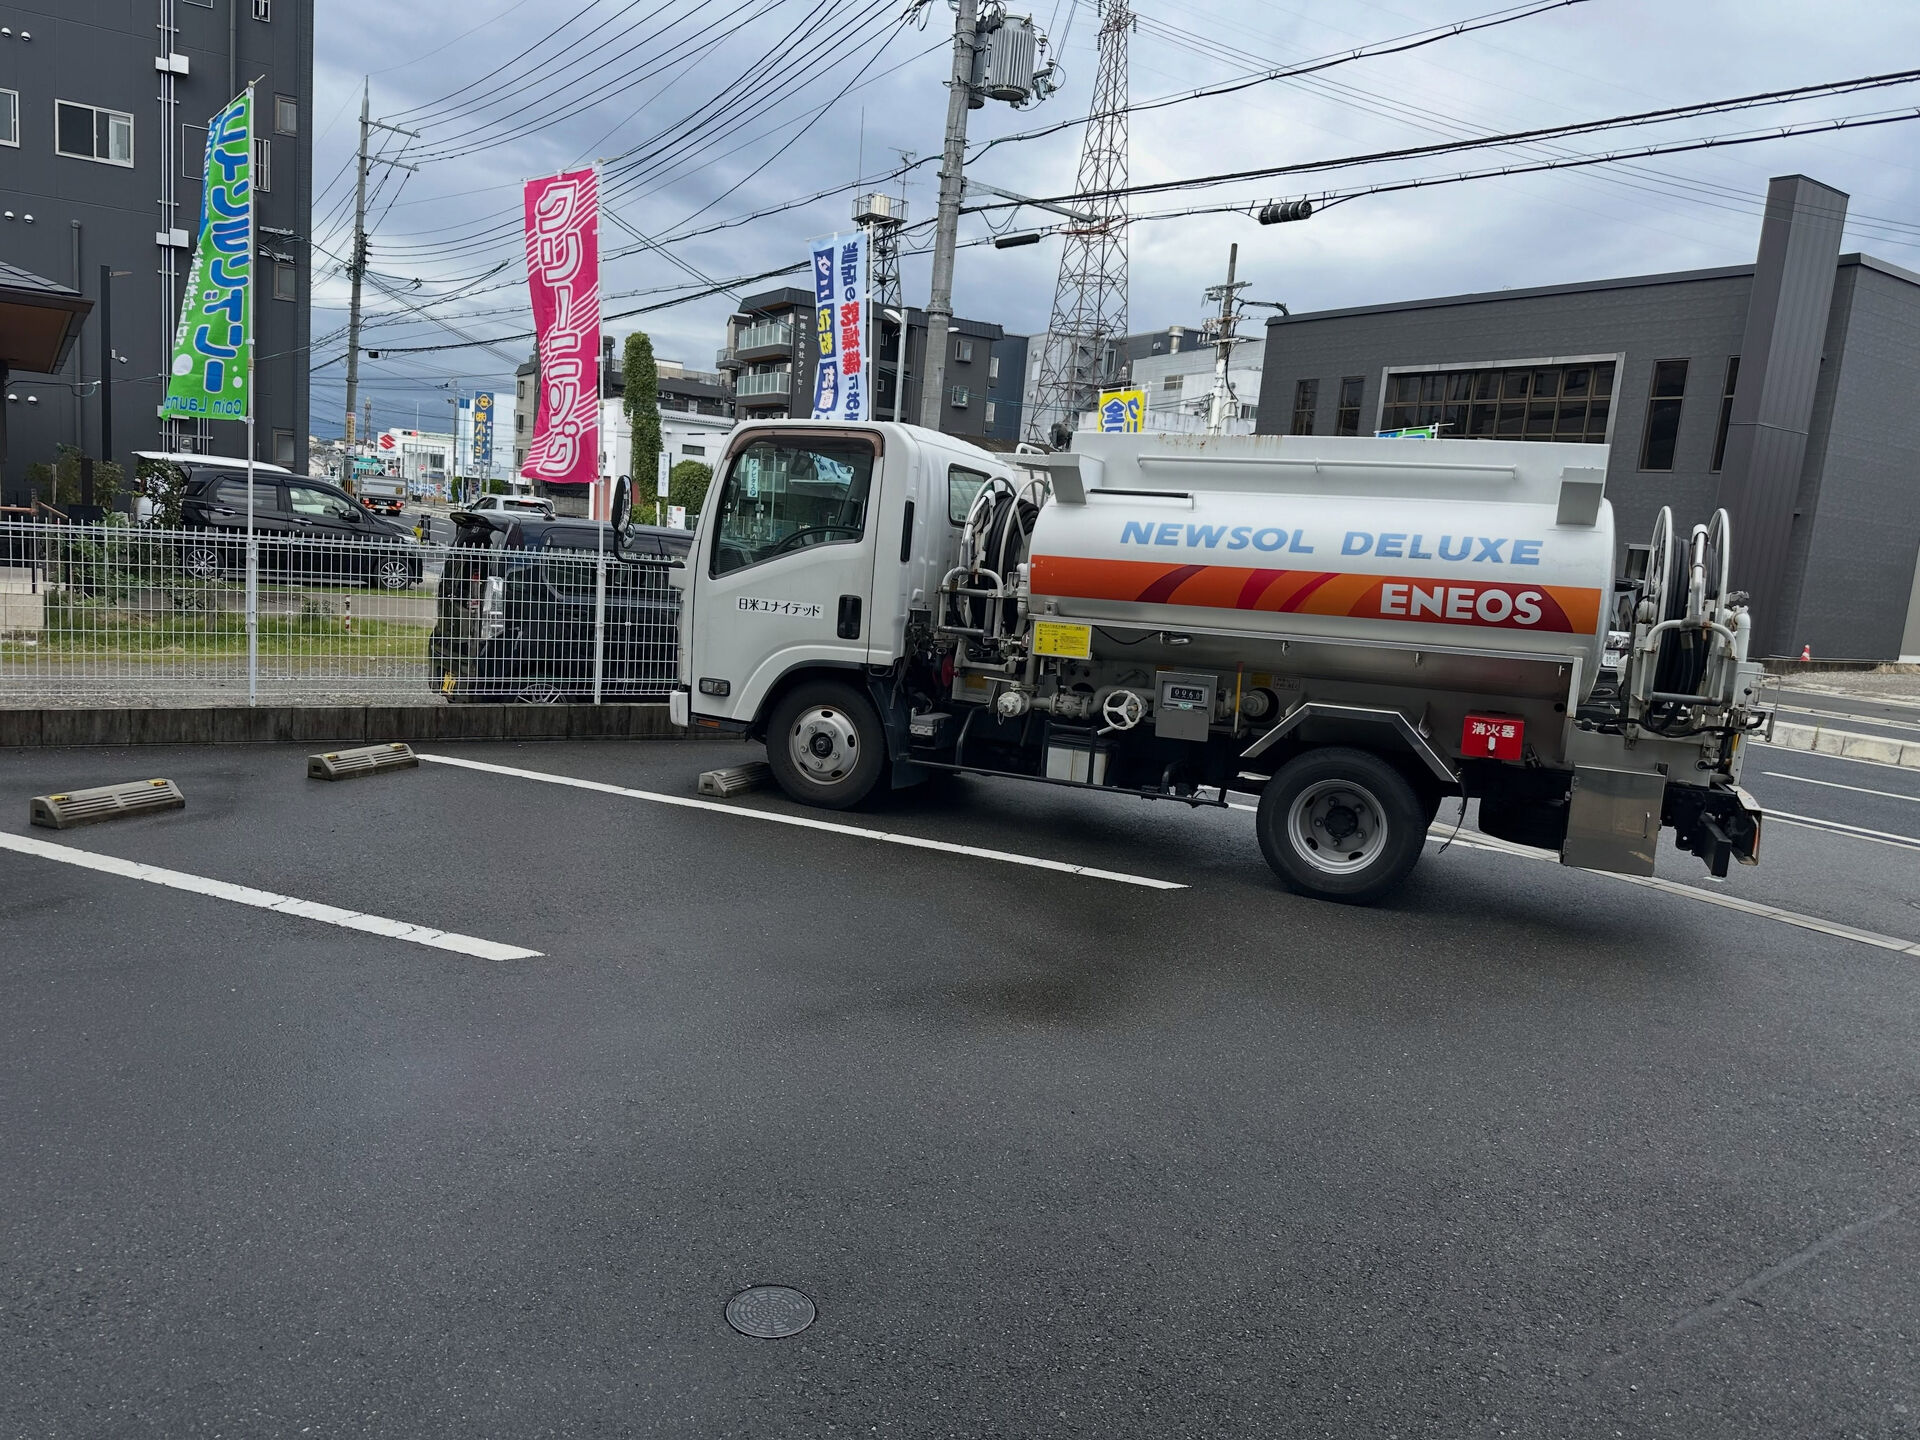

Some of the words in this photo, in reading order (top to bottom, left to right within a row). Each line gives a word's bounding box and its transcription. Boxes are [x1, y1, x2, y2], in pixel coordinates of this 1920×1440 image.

[535, 179, 582, 477] クリーニング
[1119, 520, 1315, 555] NEWSOL
[1340, 530, 1543, 566] DELUXE
[739, 597, 821, 617] 日米ユナイテッド
[1379, 583, 1543, 625] ENEOS
[1472, 722, 1515, 738] 消火器
